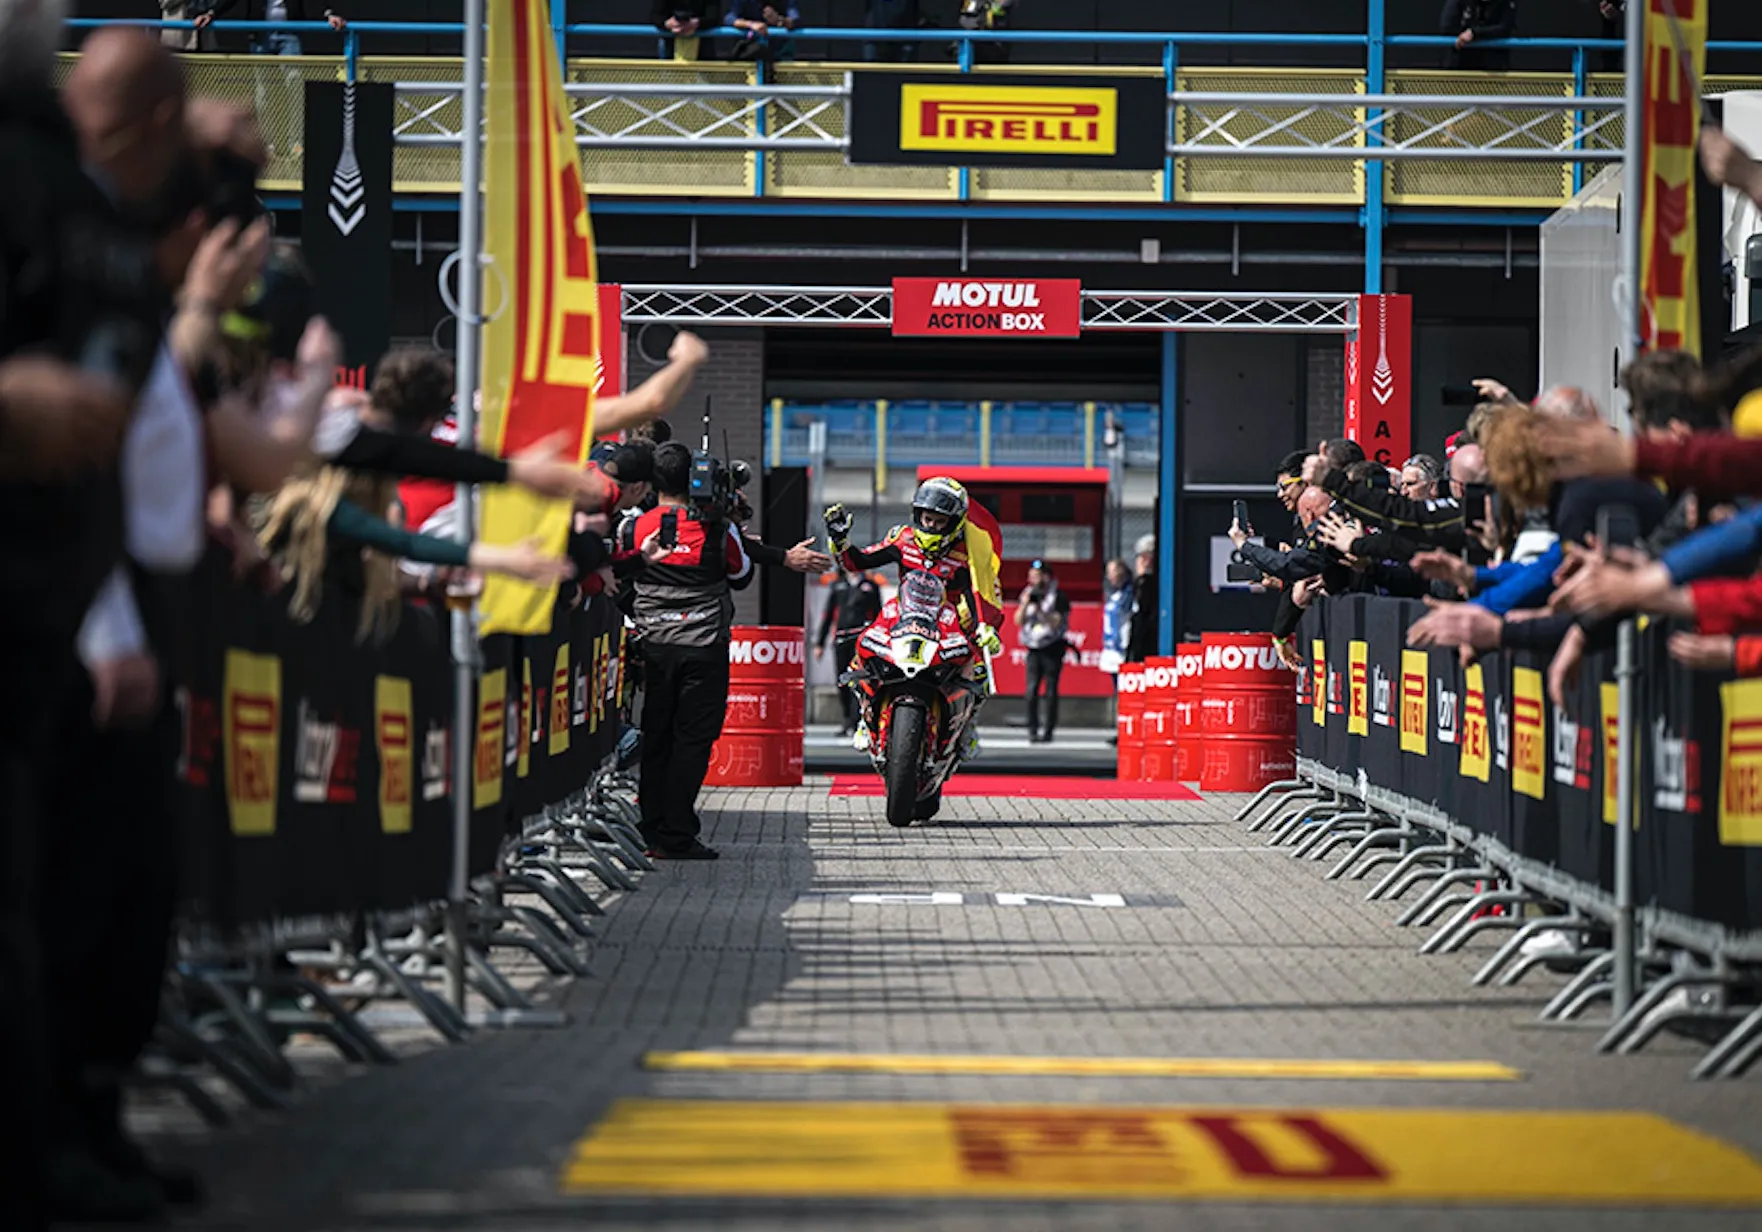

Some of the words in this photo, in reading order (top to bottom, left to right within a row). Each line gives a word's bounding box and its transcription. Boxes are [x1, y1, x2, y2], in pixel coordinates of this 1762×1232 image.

[920, 100, 1100, 141] PIRELLI
[932, 282, 1040, 308] MOTUL
[927, 313, 1045, 331] ACTIONBOX
